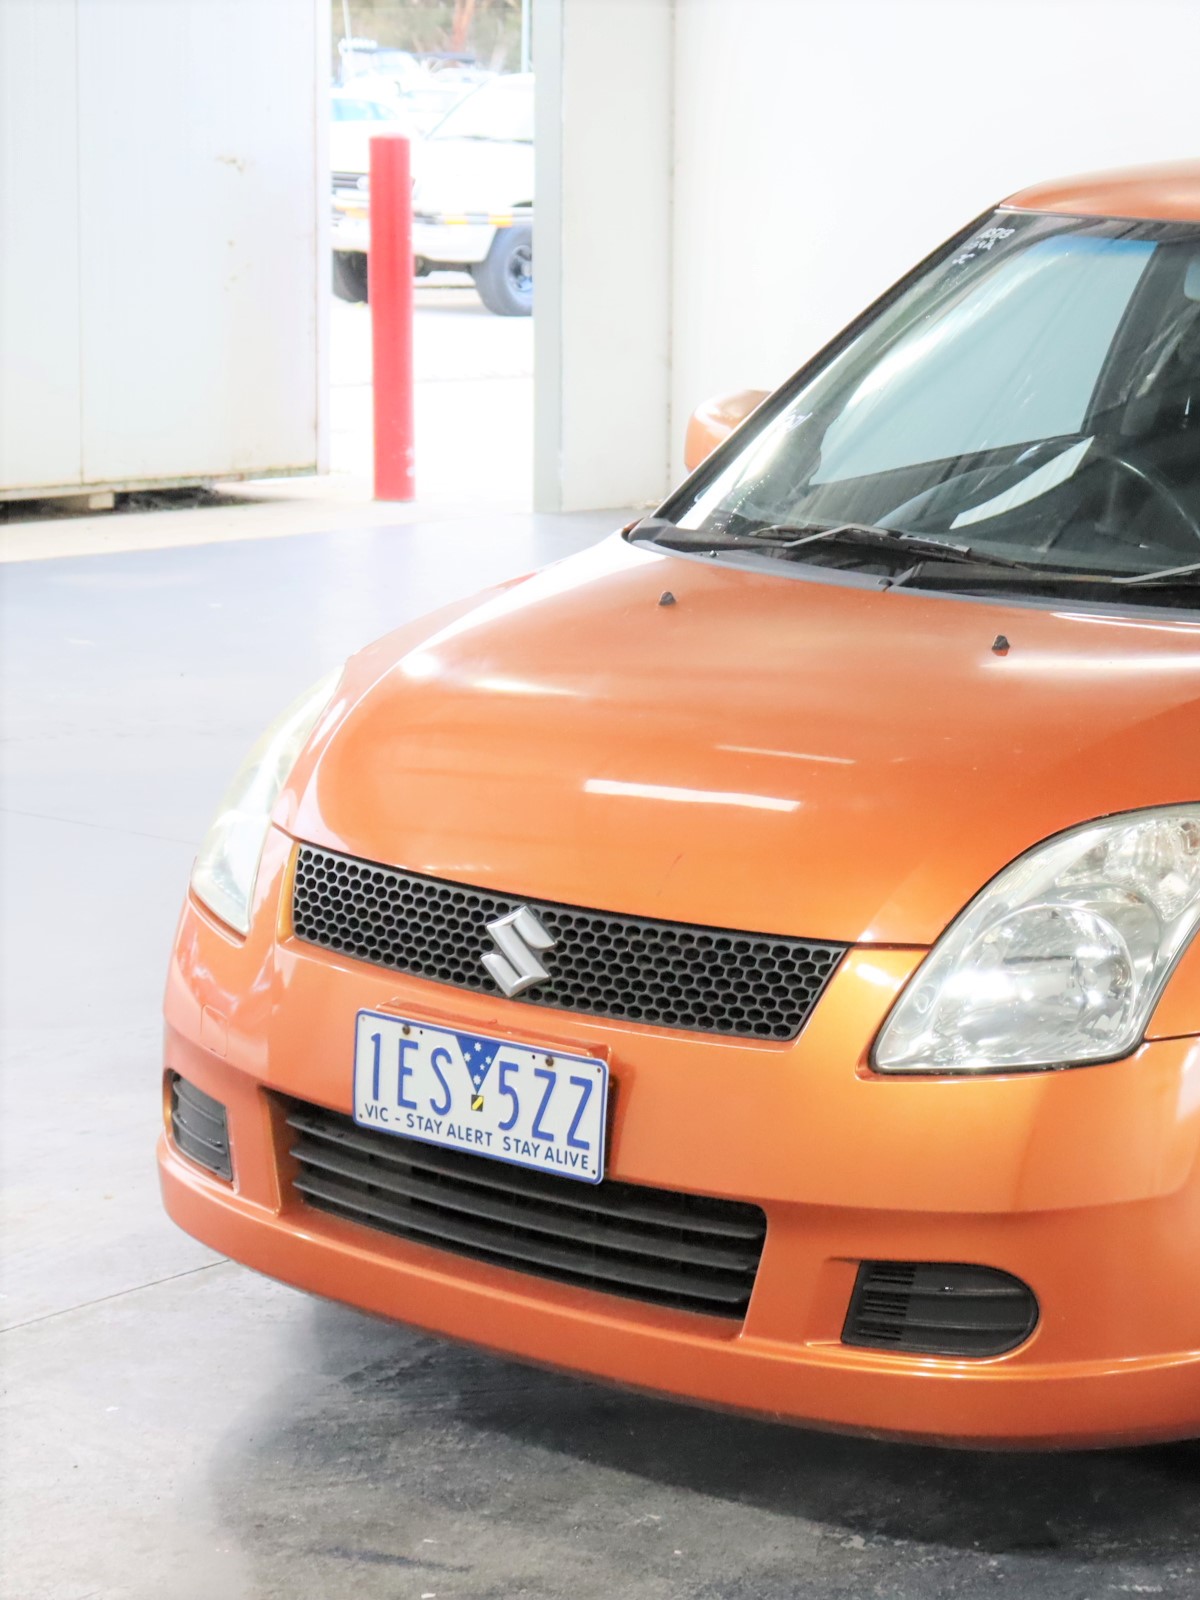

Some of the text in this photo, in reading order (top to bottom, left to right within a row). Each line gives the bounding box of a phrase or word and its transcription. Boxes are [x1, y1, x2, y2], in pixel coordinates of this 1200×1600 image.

[364, 1103, 389, 1123] VIC
[406, 1114, 443, 1136] STAY
[446, 1123, 493, 1147] ALERT
[502, 1136, 541, 1159] STAY
[544, 1145, 590, 1170] ALIVE
[370, 1032, 594, 1151] 1ES 5ZZ
